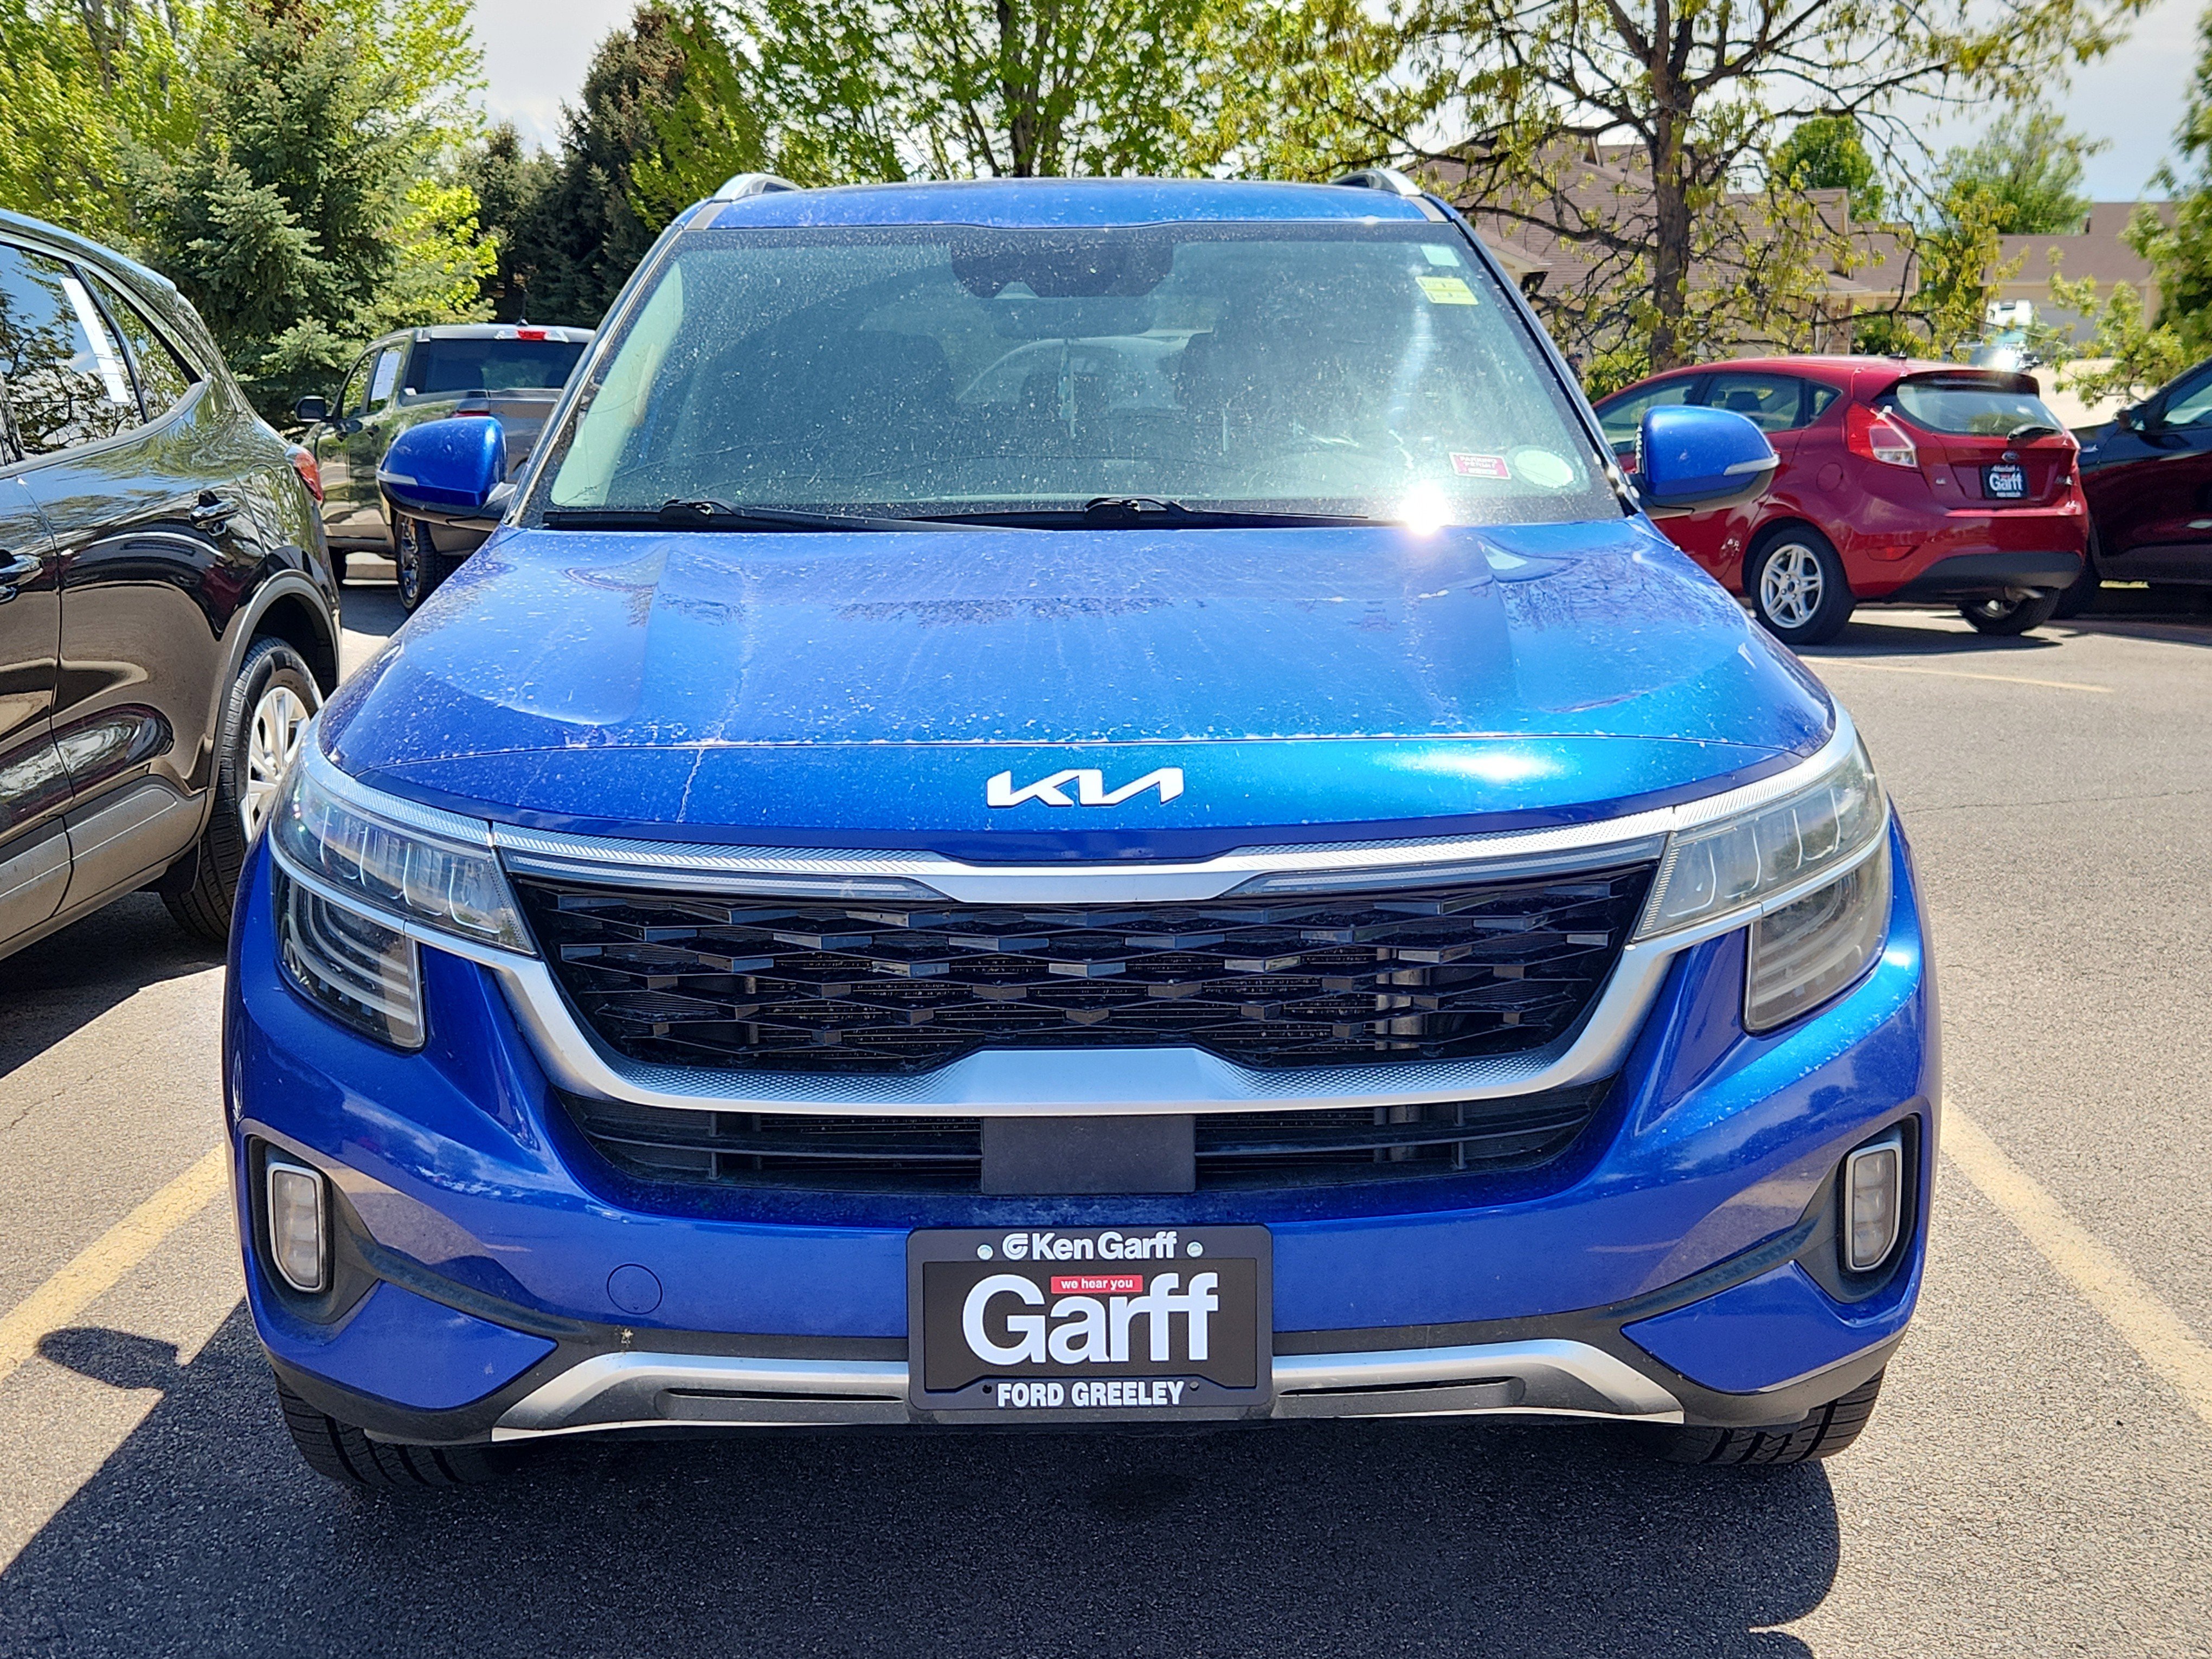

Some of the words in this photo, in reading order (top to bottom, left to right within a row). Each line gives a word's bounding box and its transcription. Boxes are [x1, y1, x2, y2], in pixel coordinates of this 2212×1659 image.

[1989, 472, 2023, 491] Garff
[987, 768, 1184, 808] KIA
[1032, 1233, 1094, 1259] Ken
[1098, 1231, 1177, 1259] Garff
[1061, 1281, 1078, 1289] we
[1082, 1278, 1108, 1289] hear
[1110, 1279, 1133, 1290] you
[962, 1272, 1218, 1365] Garff
[998, 1383, 1064, 1406] FORD
[1071, 1381, 1184, 1405] GREELEY
